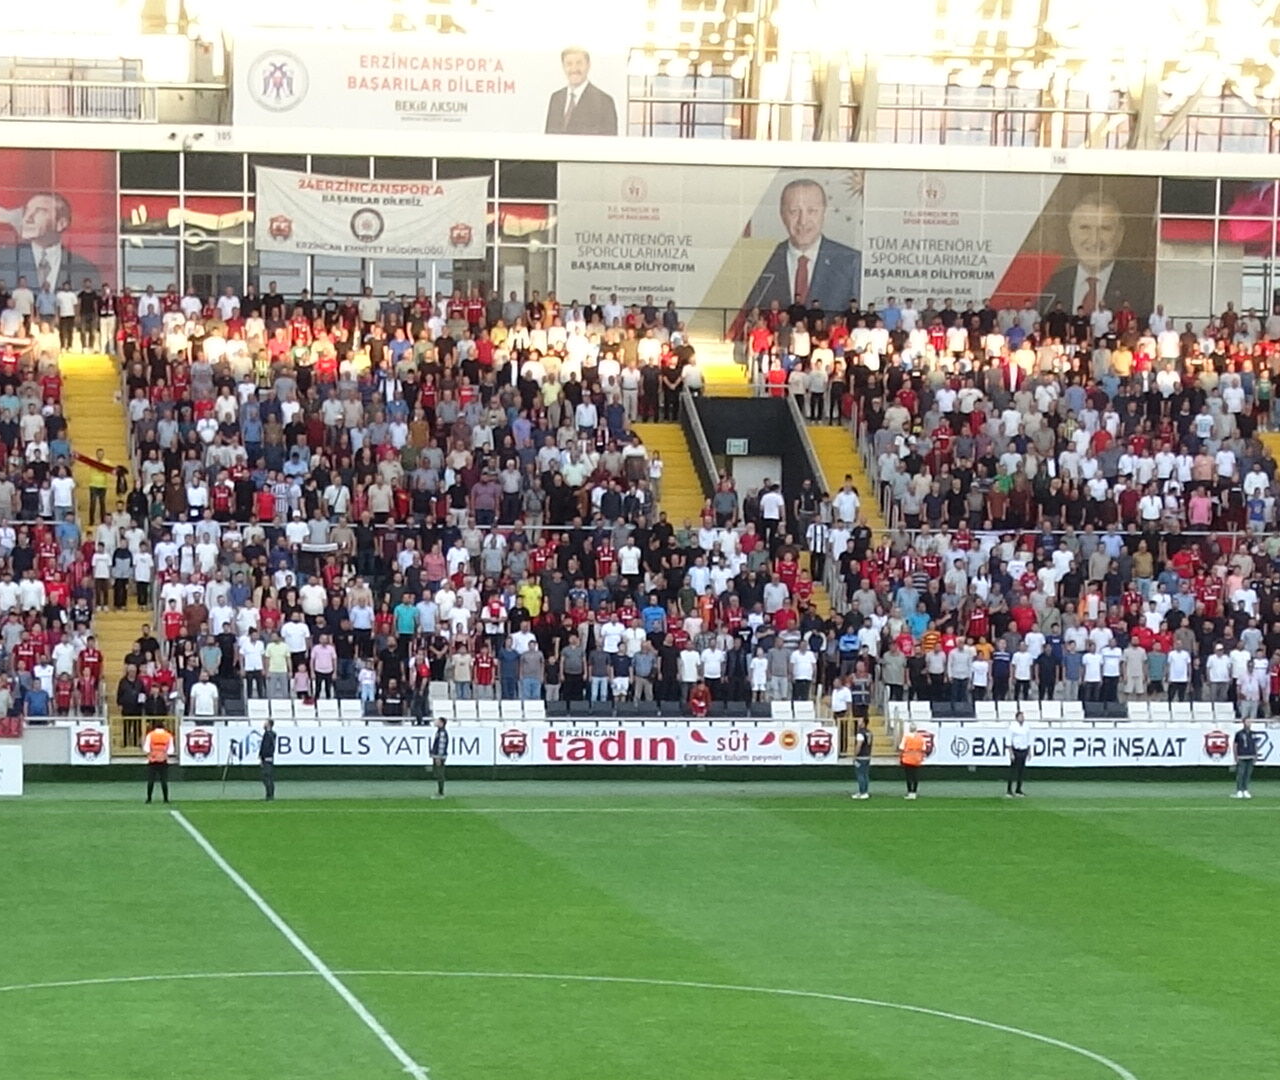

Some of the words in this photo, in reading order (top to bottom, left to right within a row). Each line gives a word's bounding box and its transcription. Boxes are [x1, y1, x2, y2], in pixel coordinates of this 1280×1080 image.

[360, 54, 504, 72] ERZİNCANSPOR'A
[347, 76, 442, 93] BAŞARILAR
[448, 76, 516, 94] DİLERİM
[575, 231, 602, 244] TÜM
[606, 232, 675, 247] ANTRENÖR
[677, 234, 693, 247] VE
[869, 236, 898, 250] TÜM
[901, 238, 973, 252] ANTRENÖR
[976, 240, 992, 253] VE
[577, 246, 689, 260] SPORCULARIMIZA
[871, 252, 988, 267] SPORCULARIMIZA
[571, 261, 632, 273] BAŞARILAR
[634, 261, 696, 273] DİLİYORUM
[864, 268, 928, 280] BAŞARILAR
[931, 268, 995, 280] DİLİYORUM
[558, 729, 617, 738] ERZİNCAN
[716, 729, 750, 752] süt
[277, 735, 371, 756] BULLS
[380, 735, 480, 756] YATIIM
[542, 731, 676, 761] tadın
[972, 737, 1066, 758] BAHDIR
[683, 752, 722, 761] Erzincan
[724, 753, 749, 761] tulum
[752, 753, 782, 763] peyniri
